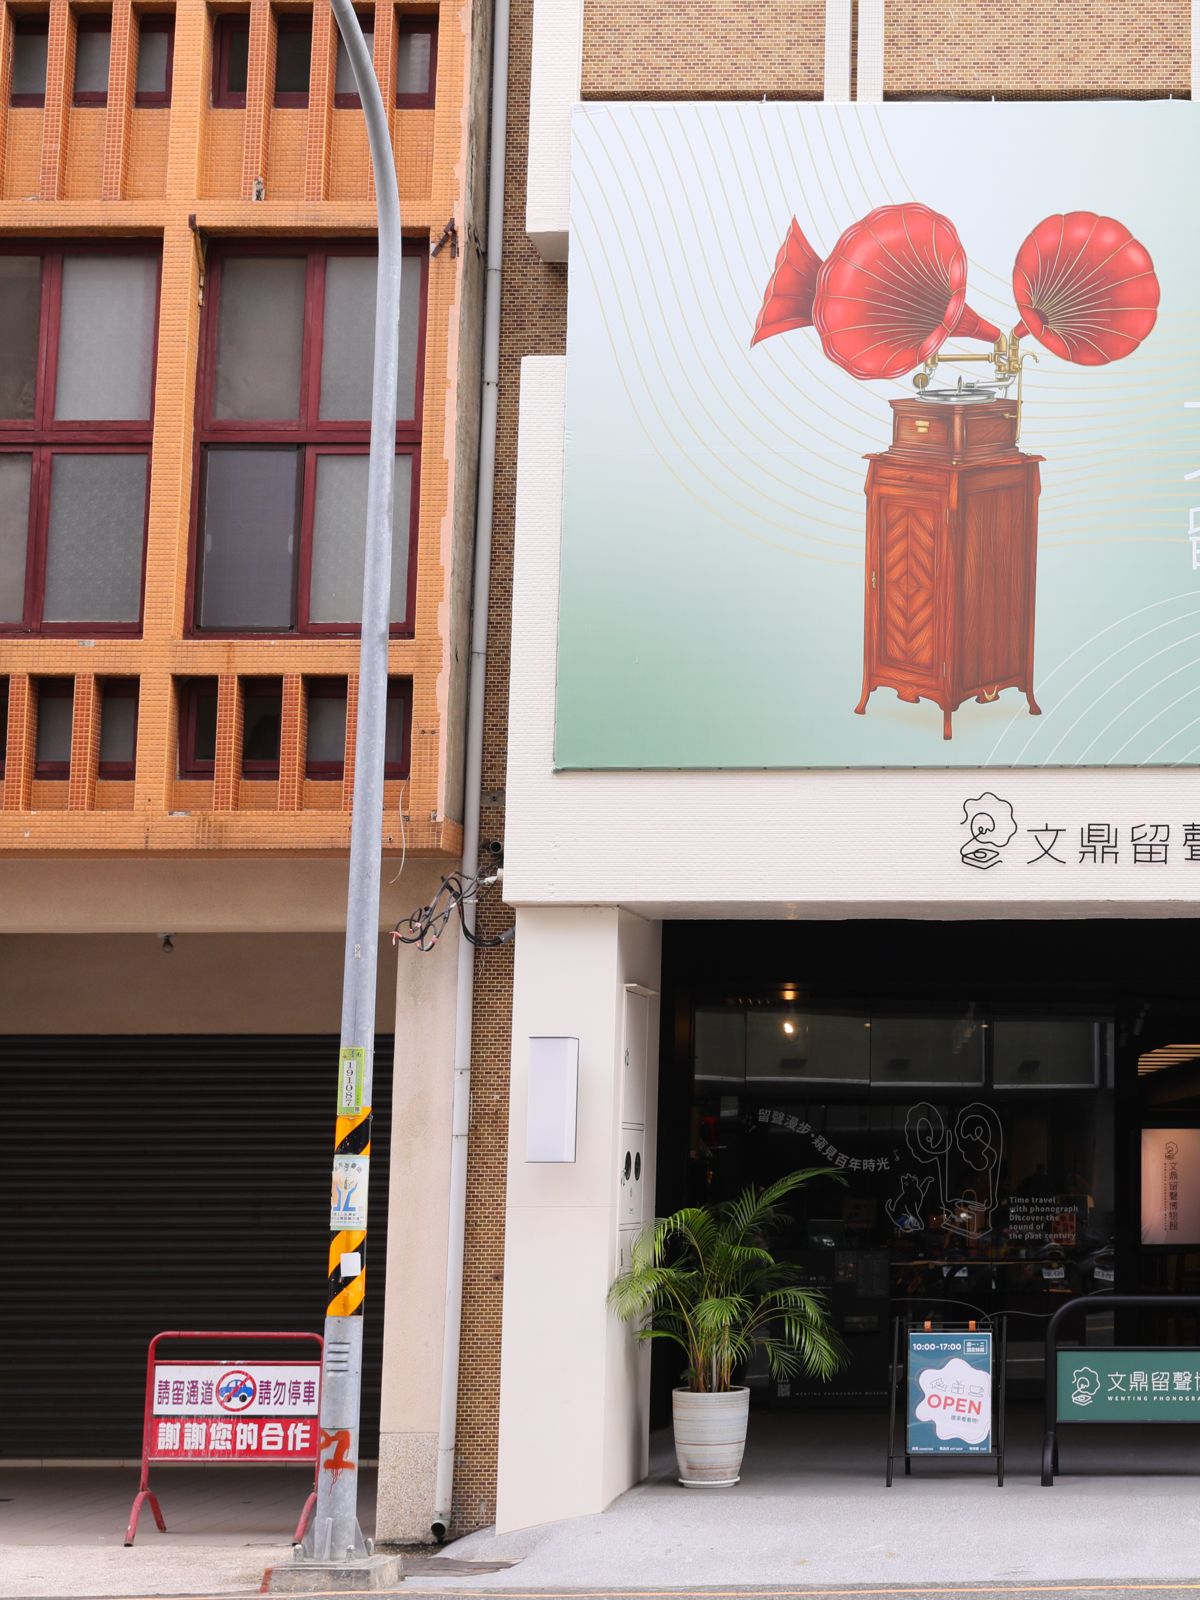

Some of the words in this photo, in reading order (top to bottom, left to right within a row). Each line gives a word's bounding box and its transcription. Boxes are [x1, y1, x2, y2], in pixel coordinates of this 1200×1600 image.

[345, 1061, 354, 1107] 191087
[1009, 1196, 1030, 1204] Time
[1031, 1196, 1056, 1204] travel
[1029, 1206, 1079, 1214] phonograph
[1009, 1232, 1024, 1240] the
[1044, 1233, 1077, 1241] century
[912, 1343, 962, 1351] 10:00-17:00
[157, 1379, 214, 1406] 請留通道
[258, 1379, 316, 1406] 請勿停車
[927, 1393, 983, 1416] OPEN
[157, 1422, 311, 1451] 謝謝您的合作
